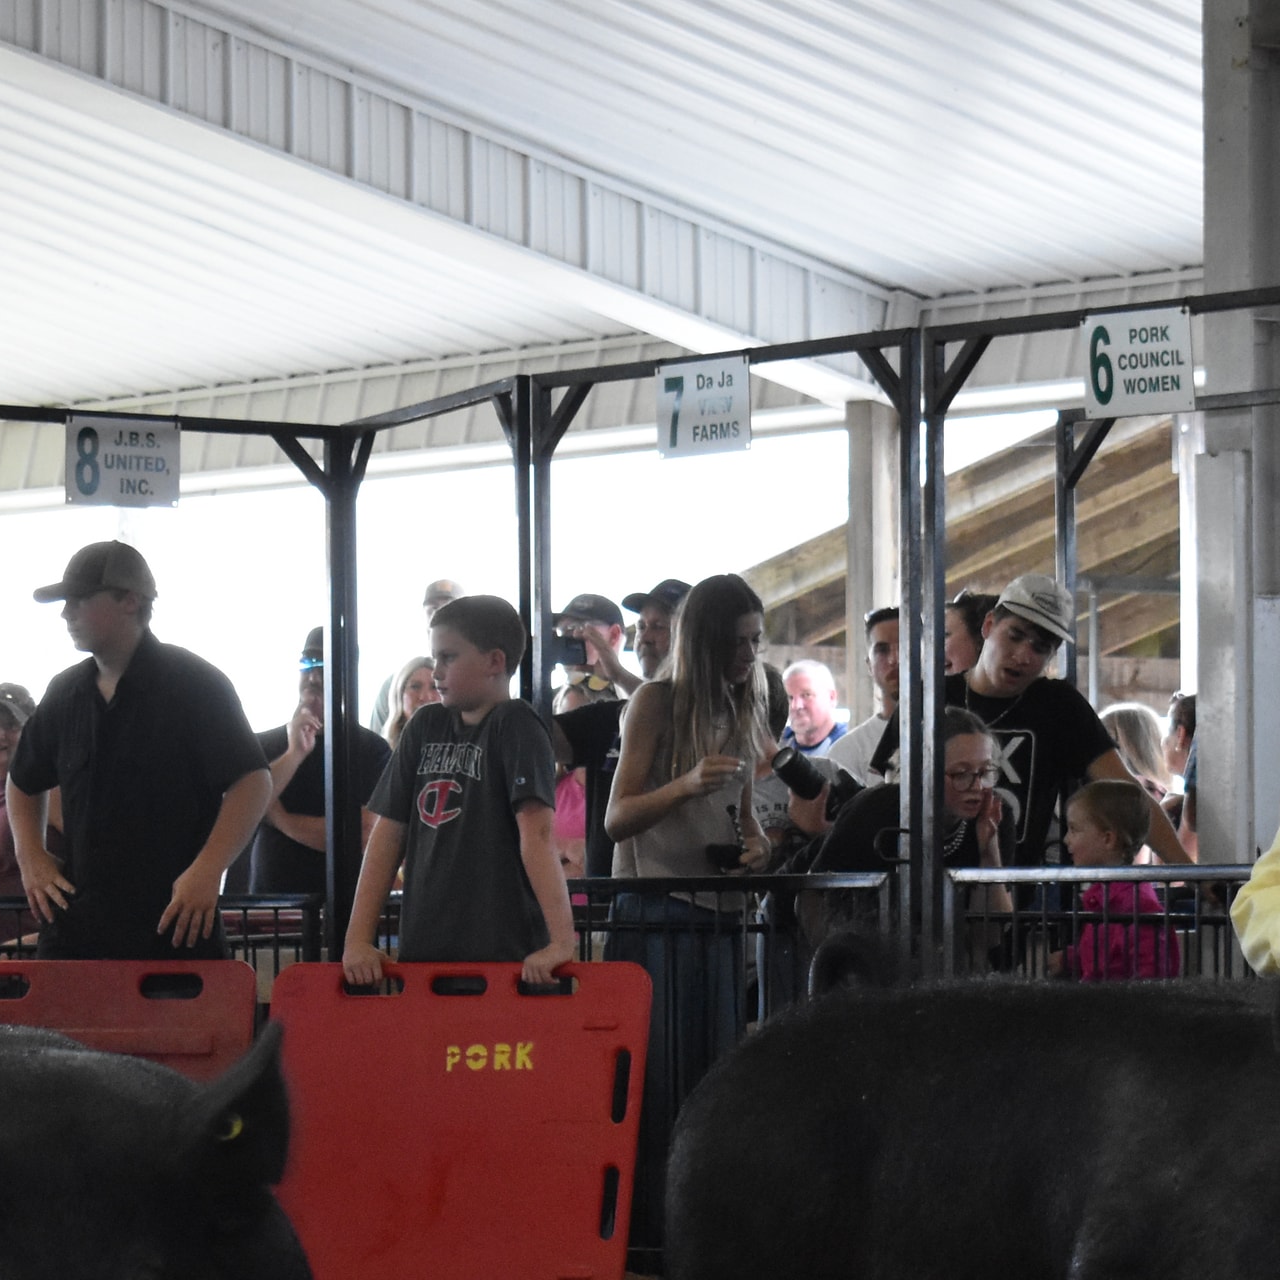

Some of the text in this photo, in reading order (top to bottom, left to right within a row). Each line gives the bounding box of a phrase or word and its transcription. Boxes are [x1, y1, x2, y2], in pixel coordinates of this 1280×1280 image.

[1128, 325, 1171, 344] PORK
[1089, 325, 1114, 406] 6
[1117, 349, 1185, 371] COUNCIL
[696, 370, 733, 391] Da Ja
[1123, 374, 1181, 395] WOMEN
[664, 375, 684, 448] 7
[114, 430, 161, 449] J.B.S.
[692, 420, 740, 442] FARMS
[75, 426, 100, 496] 8
[104, 453, 170, 476] UNITED,
[120, 478, 154, 496] INC.
[446, 1041, 534, 1072] PORK
